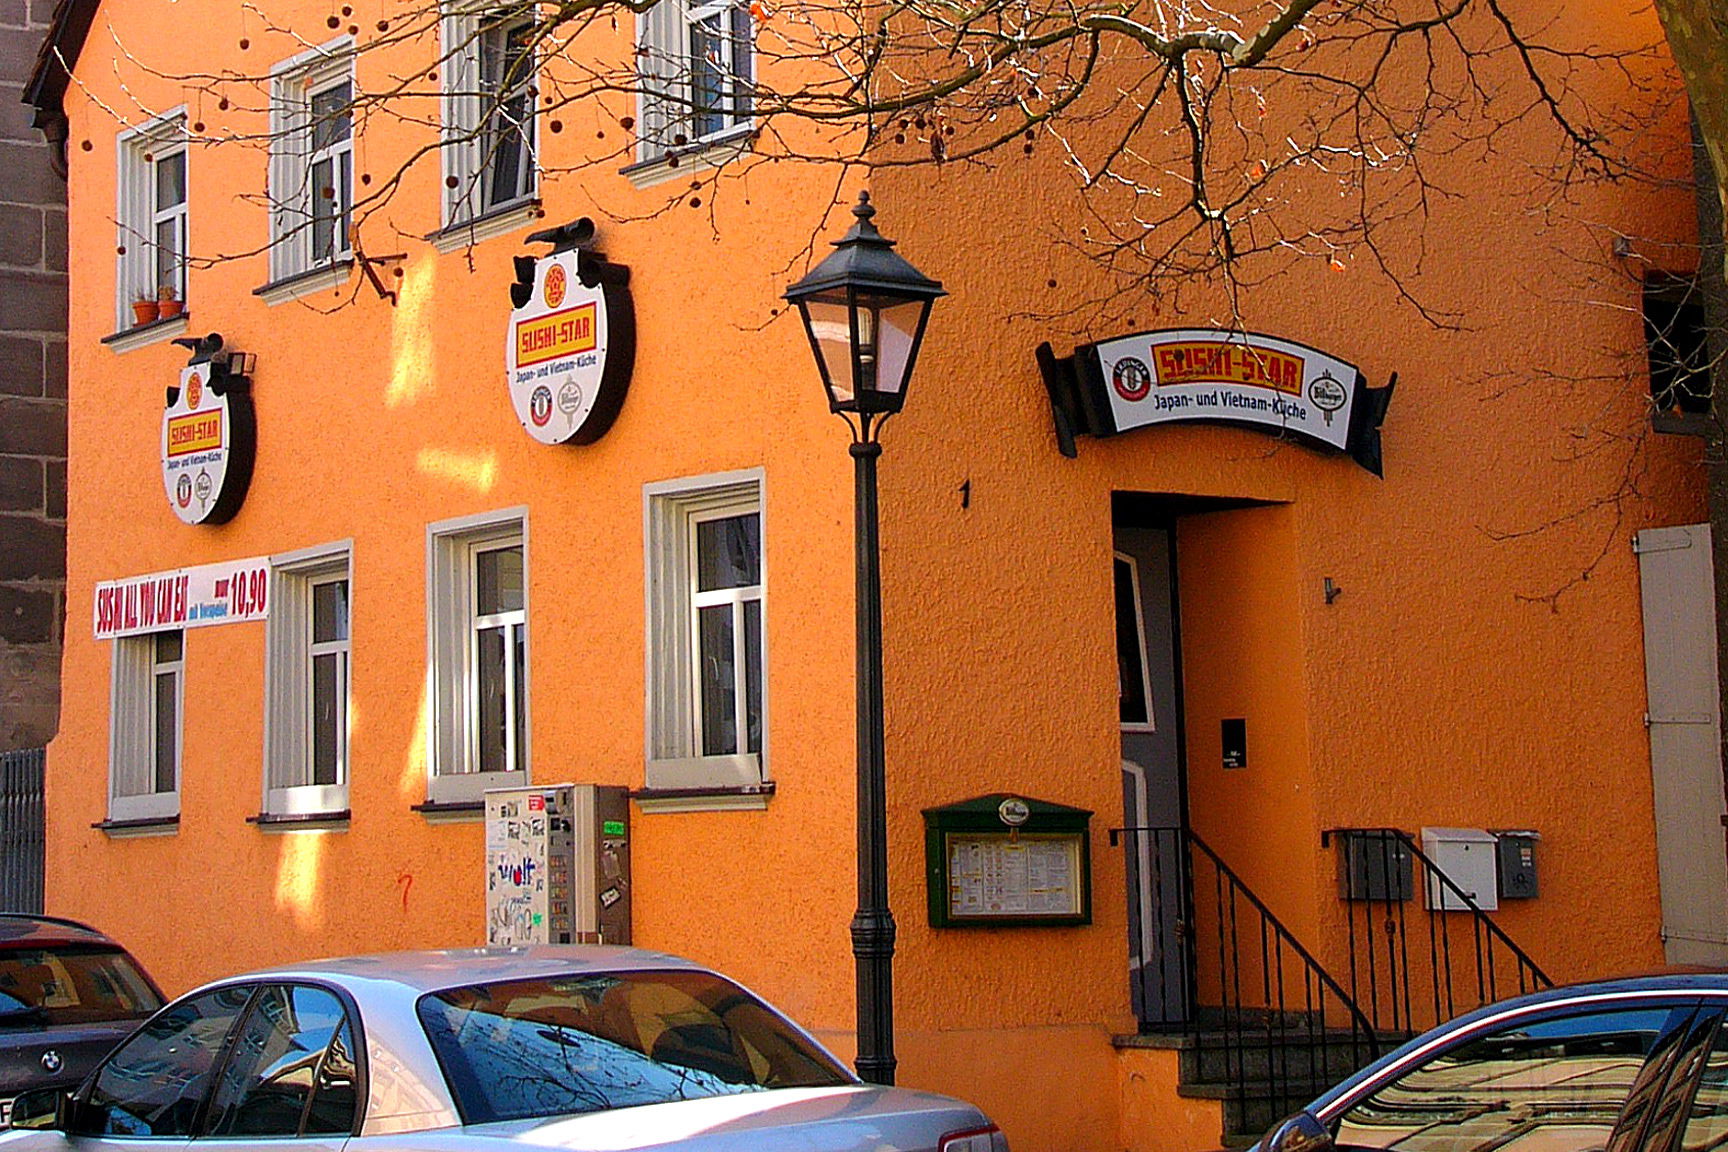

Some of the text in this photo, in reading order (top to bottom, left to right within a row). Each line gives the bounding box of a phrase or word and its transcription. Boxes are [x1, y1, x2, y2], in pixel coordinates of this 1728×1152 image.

[521, 316, 590, 354] SUSHI-STAR
[1159, 347, 1298, 389] SUSHI-STAR
[1154, 394, 1193, 412] Japan-
[1196, 390, 1218, 406] und
[171, 419, 218, 446] SUSHI-STAR
[231, 568, 267, 619] 10,90
